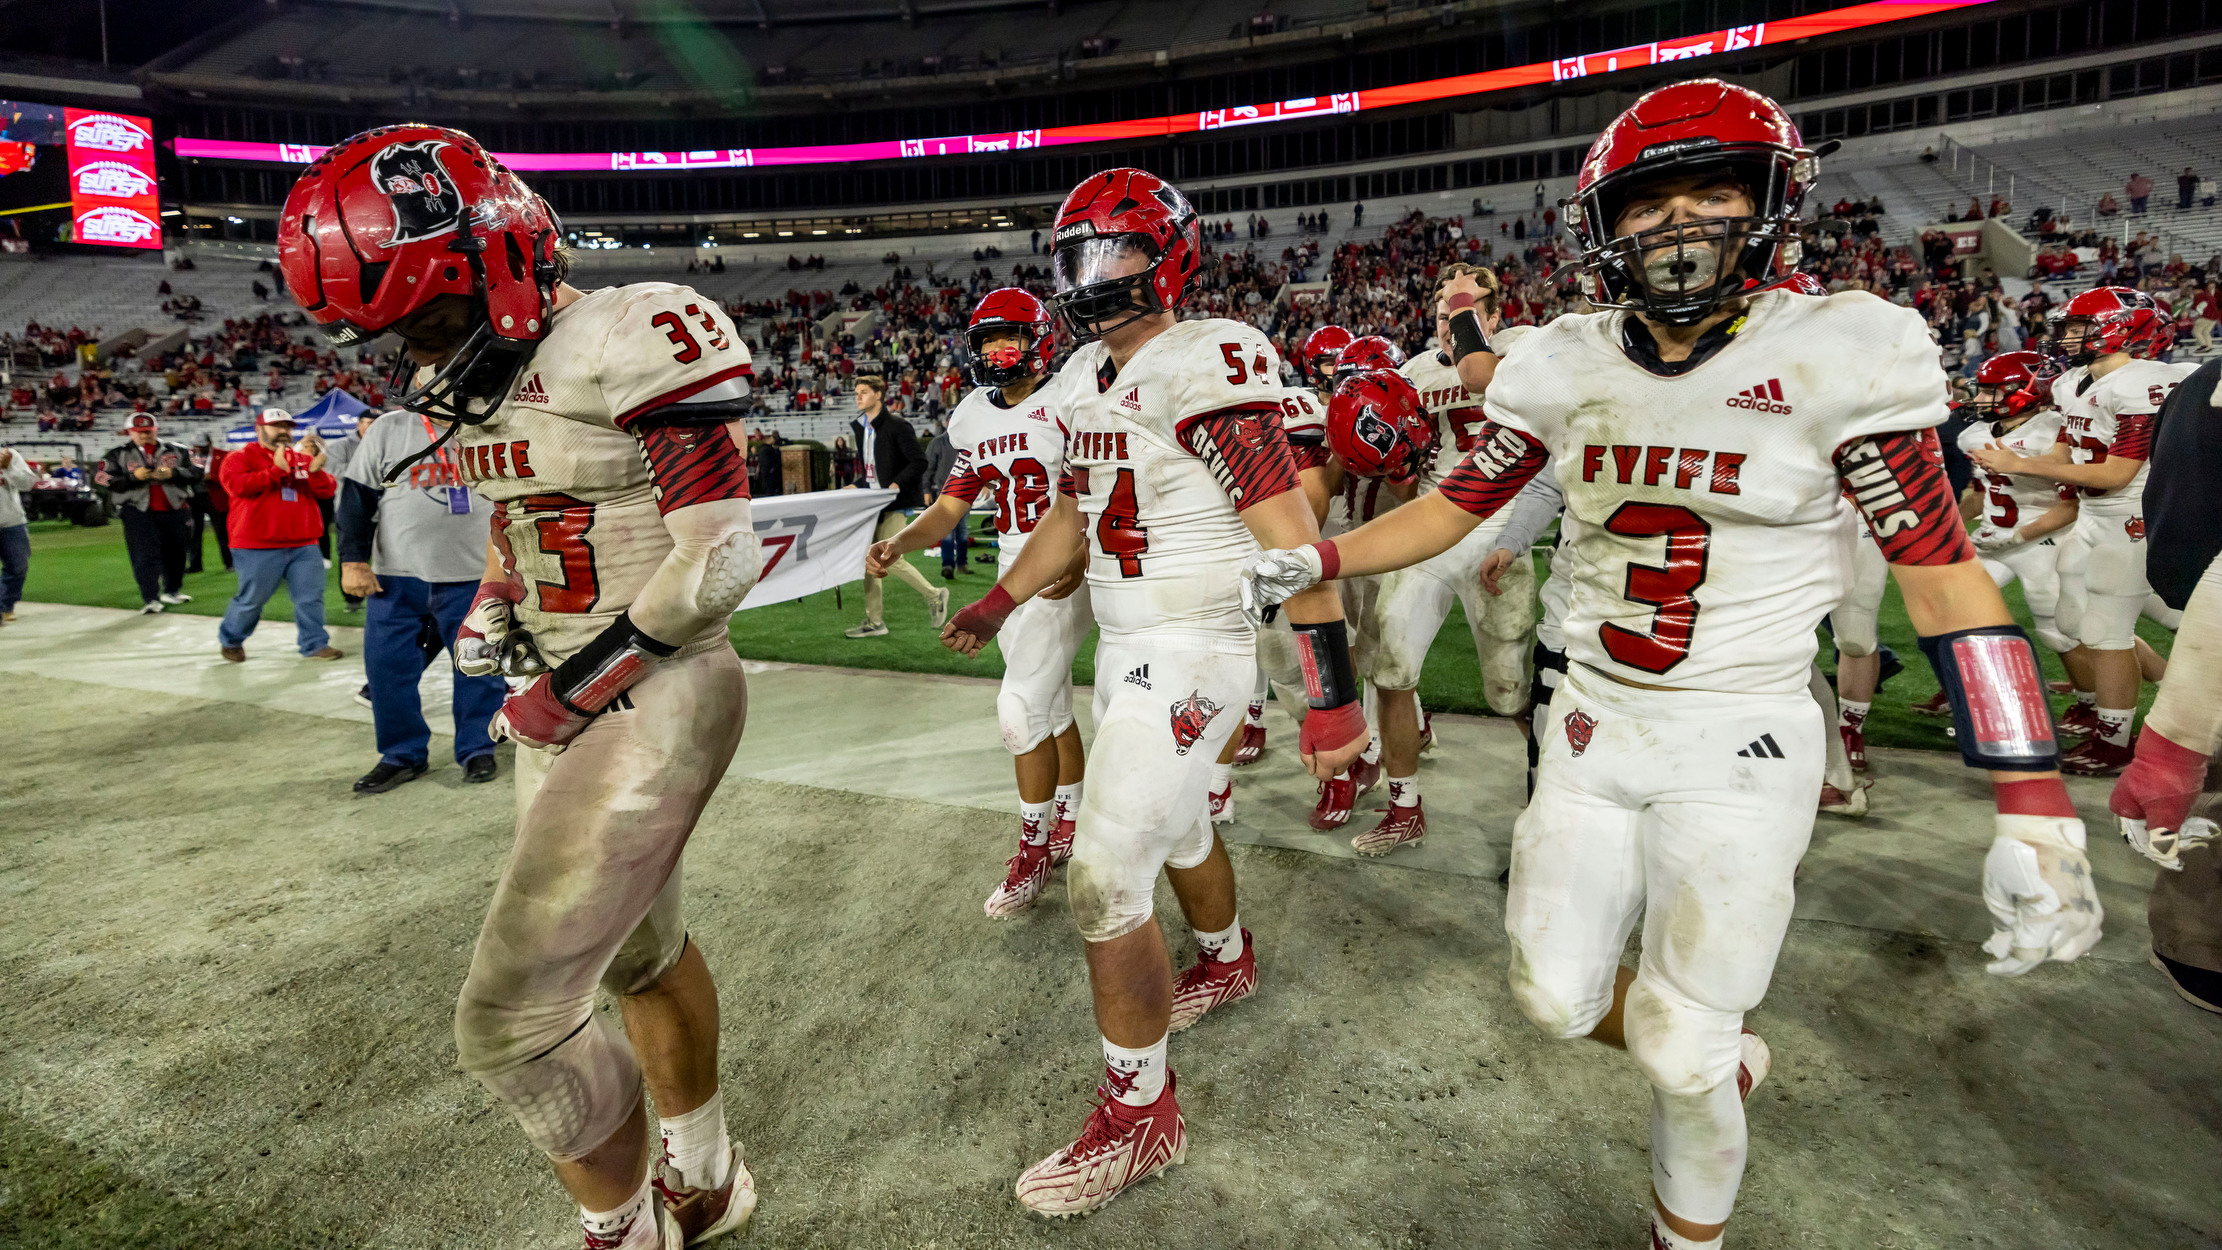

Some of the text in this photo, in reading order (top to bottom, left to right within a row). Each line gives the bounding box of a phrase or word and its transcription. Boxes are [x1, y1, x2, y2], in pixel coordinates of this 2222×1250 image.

[1056, 223, 1089, 241] Riddell
[651, 303, 729, 364] 33
[1219, 343, 1269, 385] 54
[513, 392, 549, 404] adidas
[1120, 400, 1141, 412] adidas
[1282, 396, 1313, 418] 66
[1726, 396, 1792, 415] adidas
[978, 433, 1029, 460] FYFFE
[1472, 427, 1527, 480] RED
[1582, 444, 1747, 495] FYFFE
[1985, 474, 2019, 528] 5
[1599, 500, 1712, 675] 3
[1124, 675, 1152, 690] adidas
